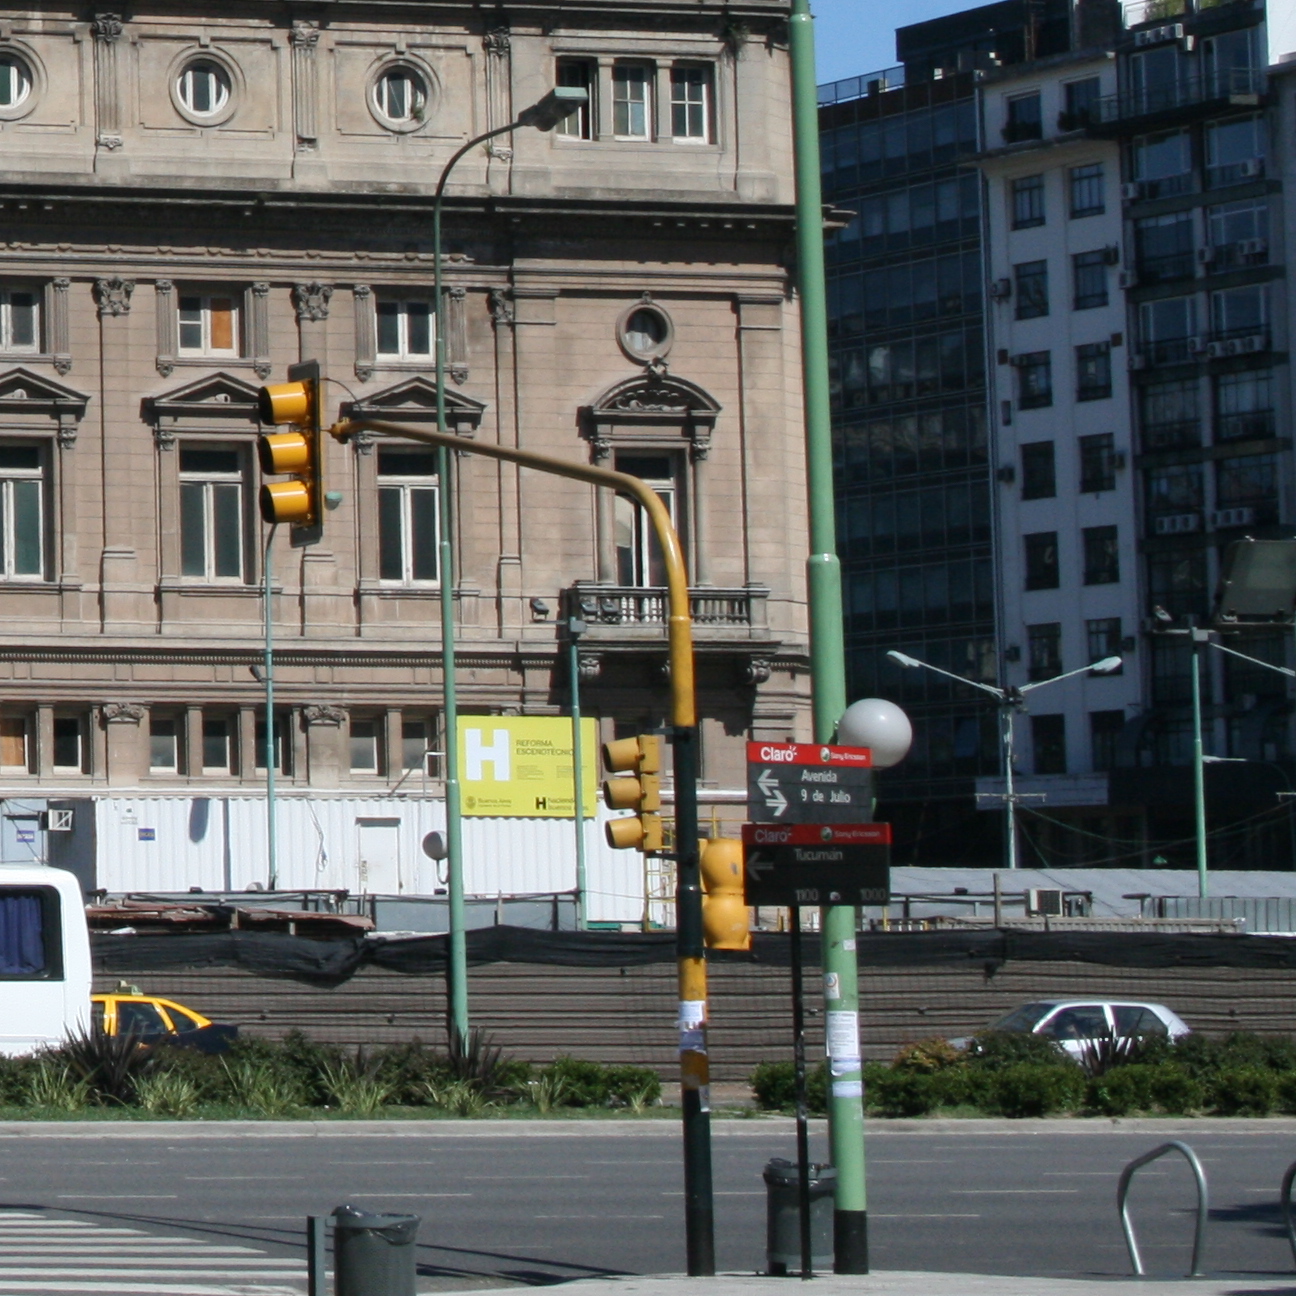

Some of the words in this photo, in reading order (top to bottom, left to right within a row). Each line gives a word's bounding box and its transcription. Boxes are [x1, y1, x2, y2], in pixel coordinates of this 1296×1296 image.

[465, 729, 510, 781] H
[516, 748, 575, 756] ESCENOTECNIC
[761, 746, 794, 762] Claro
[801, 769, 838, 783] Avenida
[801, 789, 808, 802] 9
[813, 790, 825, 802] de
[830, 790, 851, 803] Julio
[754, 829, 788, 843] Claro
[794, 847, 843, 861] Tucumán
